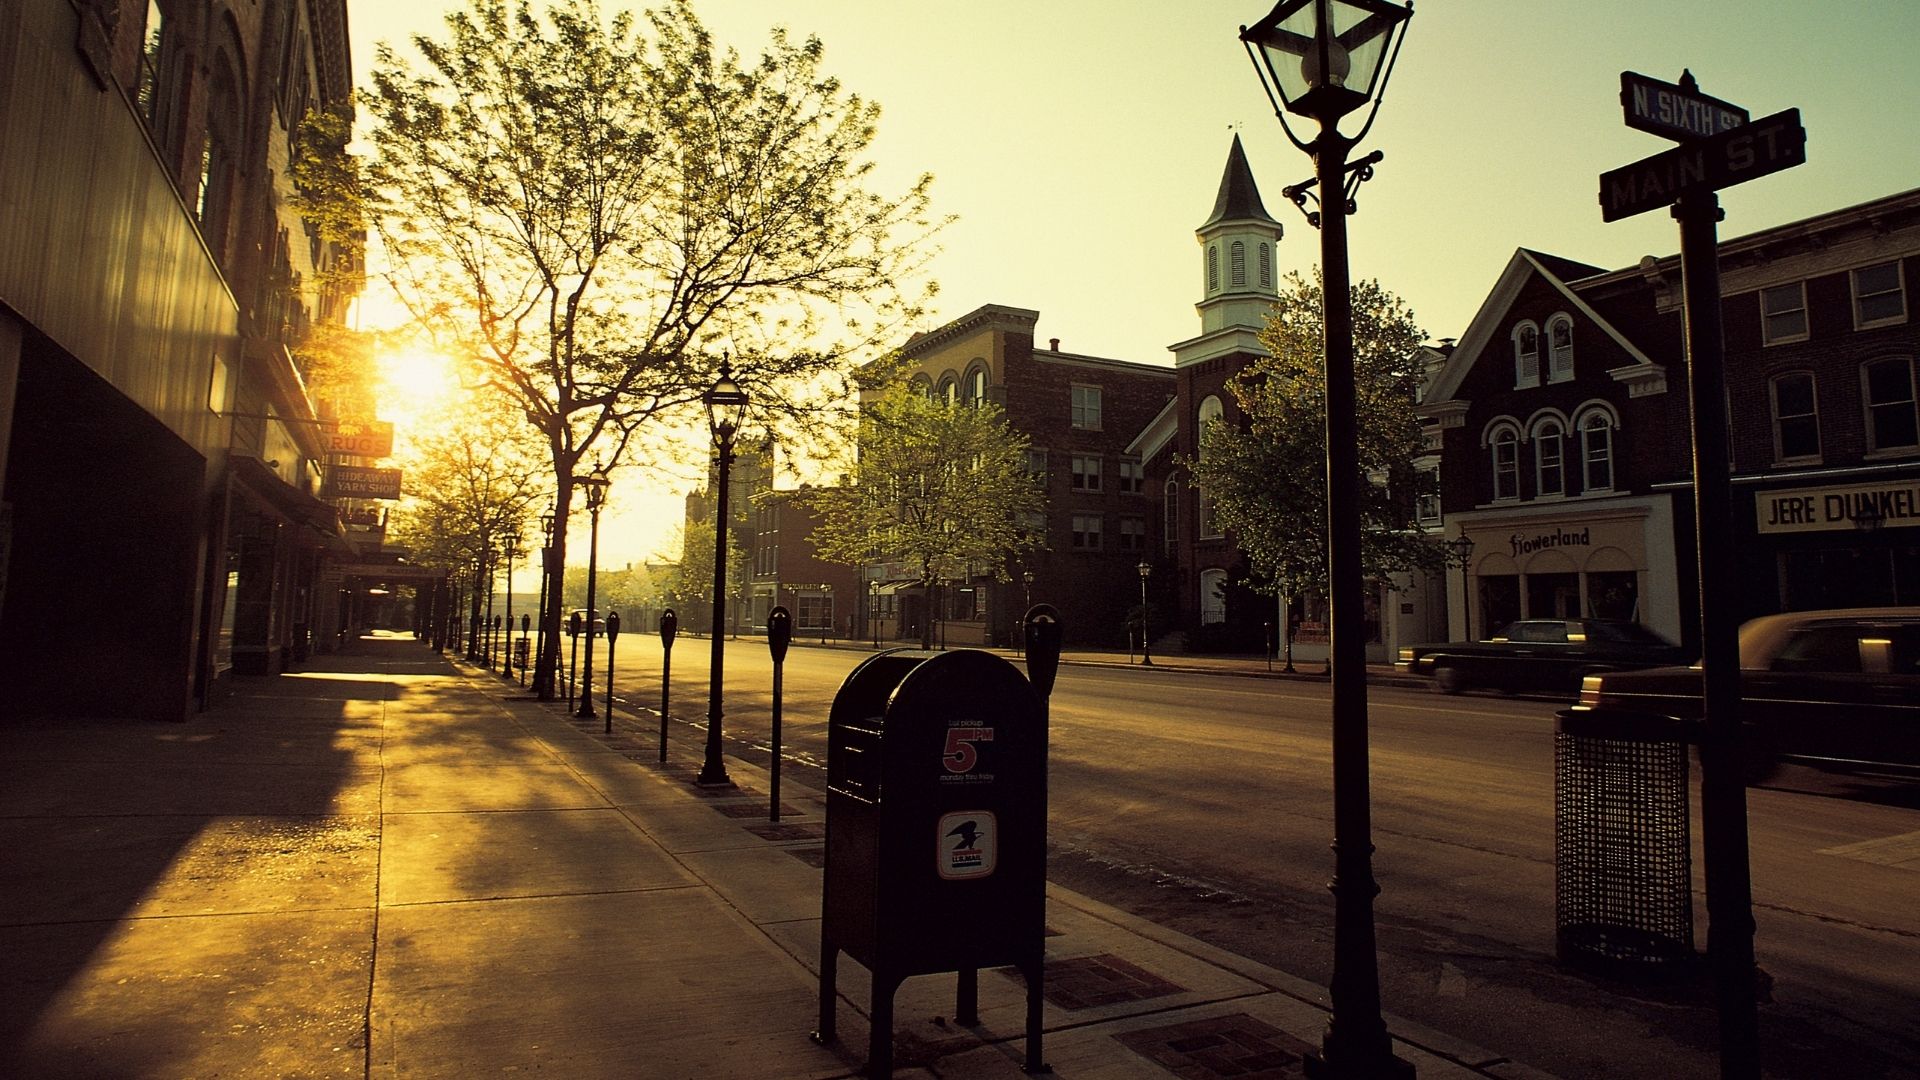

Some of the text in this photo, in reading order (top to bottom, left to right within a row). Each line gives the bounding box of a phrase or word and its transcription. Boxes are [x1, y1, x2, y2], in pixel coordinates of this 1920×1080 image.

[1611, 124, 1792, 210] MAIN ST.
[337, 471, 395, 483] HIDEAWAY
[337, 481, 396, 493] YARN SHOP
[1768, 489, 1920, 525] JERE DUNKEL
[943, 727, 978, 773] 5
